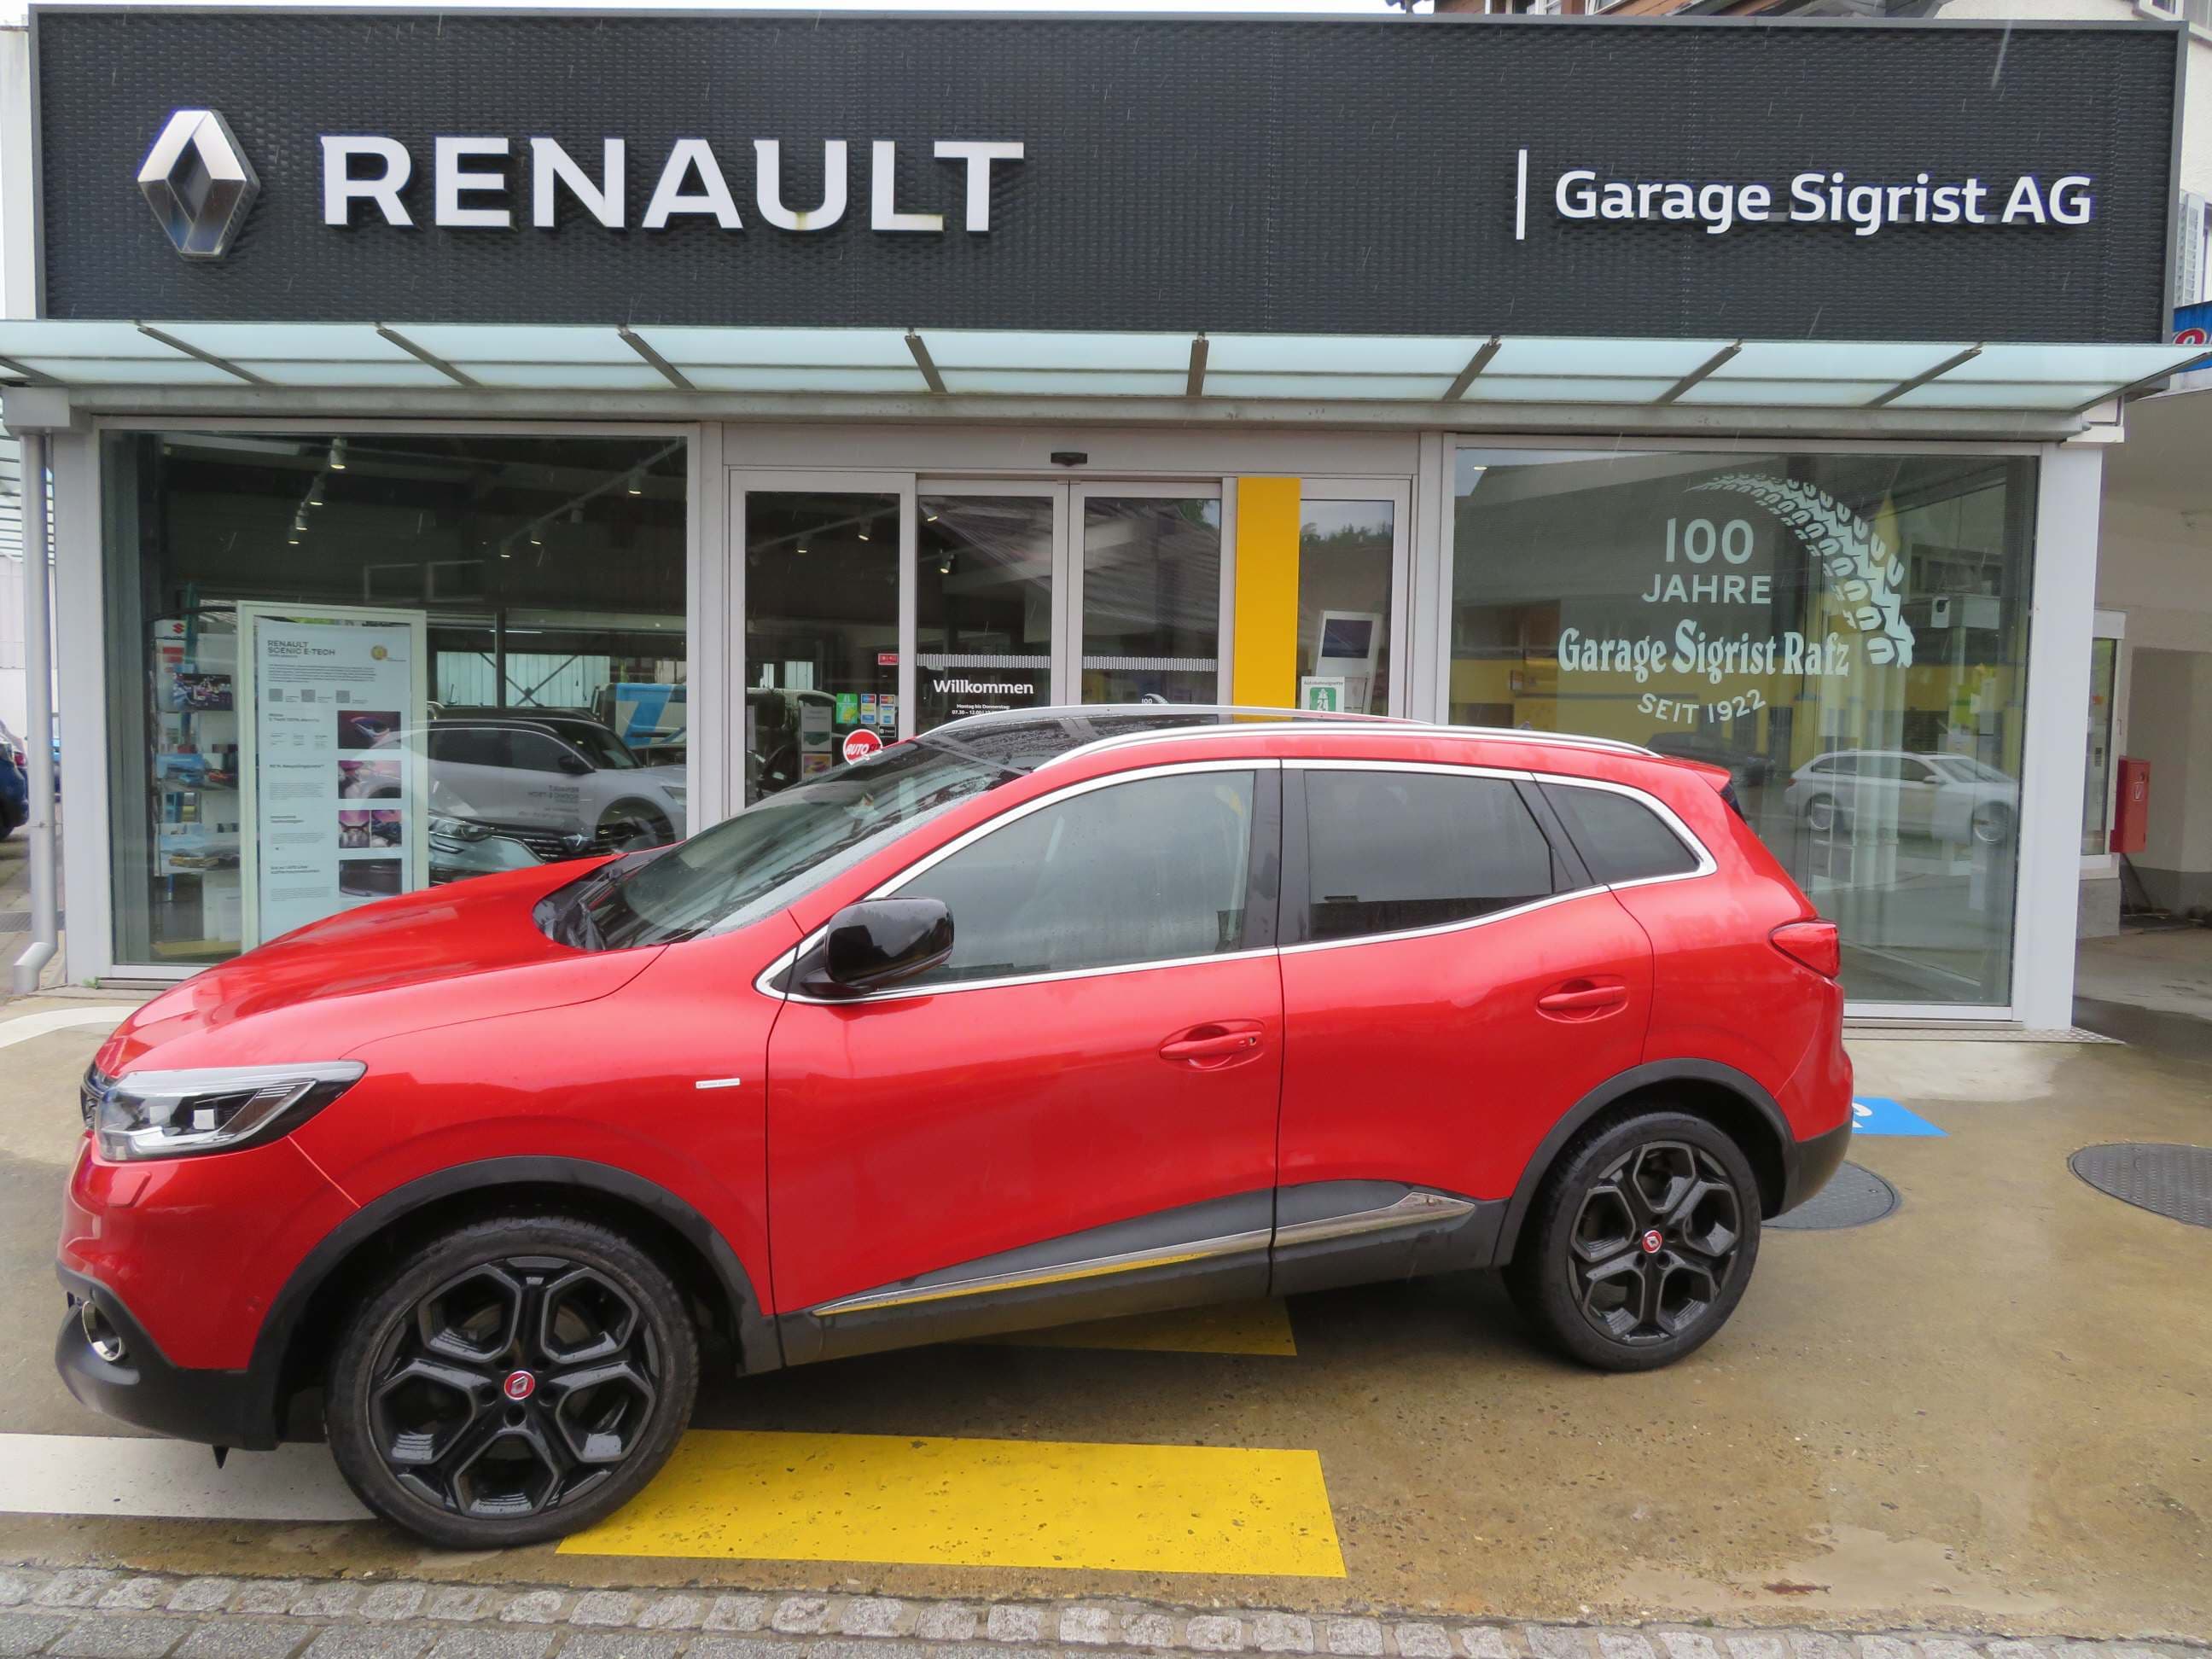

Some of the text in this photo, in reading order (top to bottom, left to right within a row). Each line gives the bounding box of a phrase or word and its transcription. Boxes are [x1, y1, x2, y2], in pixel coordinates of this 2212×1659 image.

[320, 136, 1024, 232] RENAULT
[1555, 170, 2091, 236] Garage Sigrist AG
[1666, 517, 1754, 564] 100
[1642, 574, 1772, 604] JAHRE
[1558, 619, 1850, 684] Garage Sigrist Rafz
[933, 679, 1034, 695] Willkommen
[1638, 689, 1767, 725] SEIT 1922
